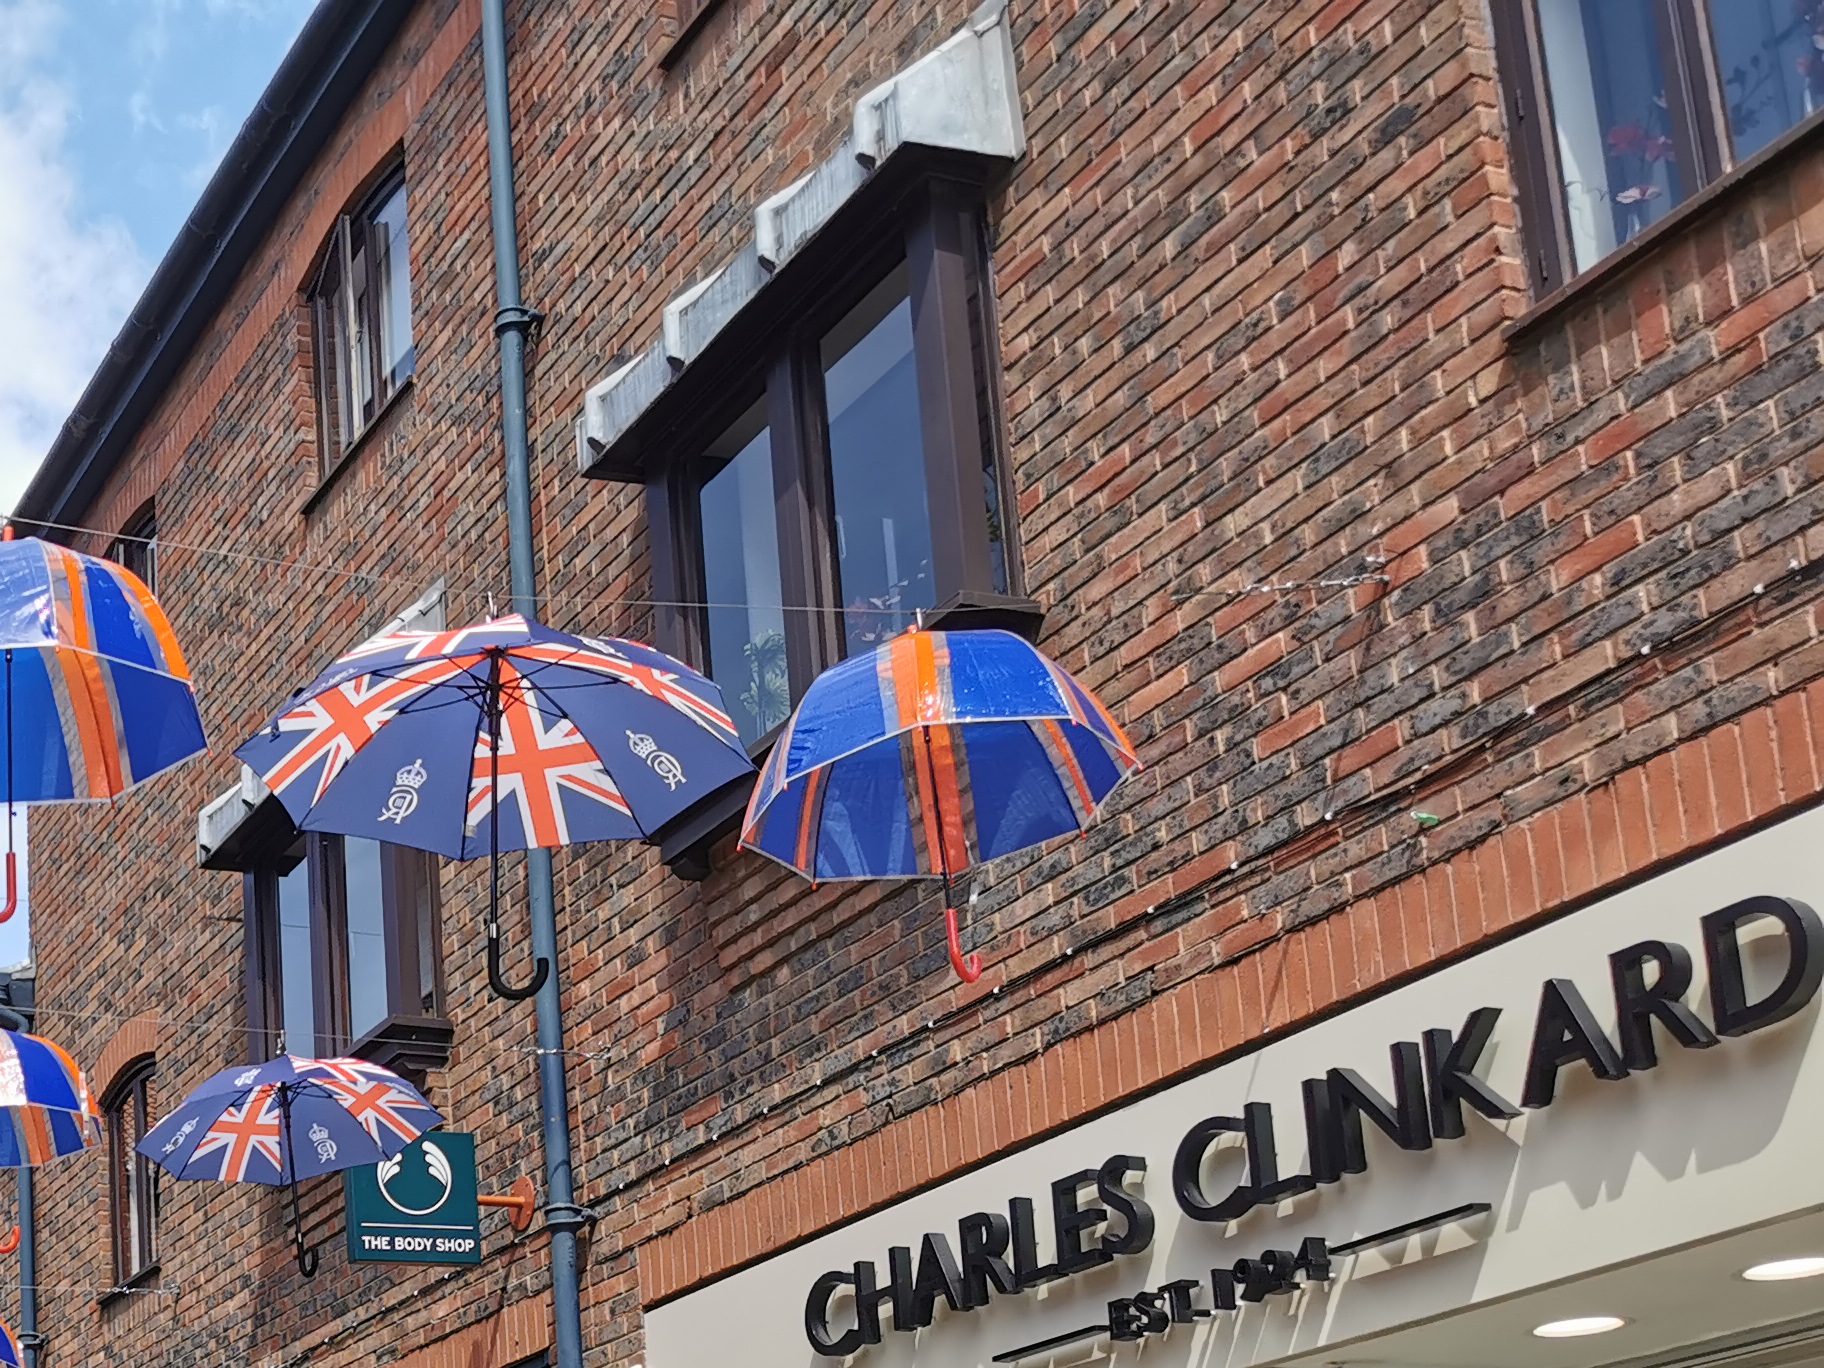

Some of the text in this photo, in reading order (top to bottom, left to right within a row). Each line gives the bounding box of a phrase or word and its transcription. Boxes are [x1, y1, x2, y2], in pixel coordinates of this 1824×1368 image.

[361, 1235, 475, 1252] THE BODY SHOP
[805, 895, 1824, 1358] CHARLES CLINKARD
